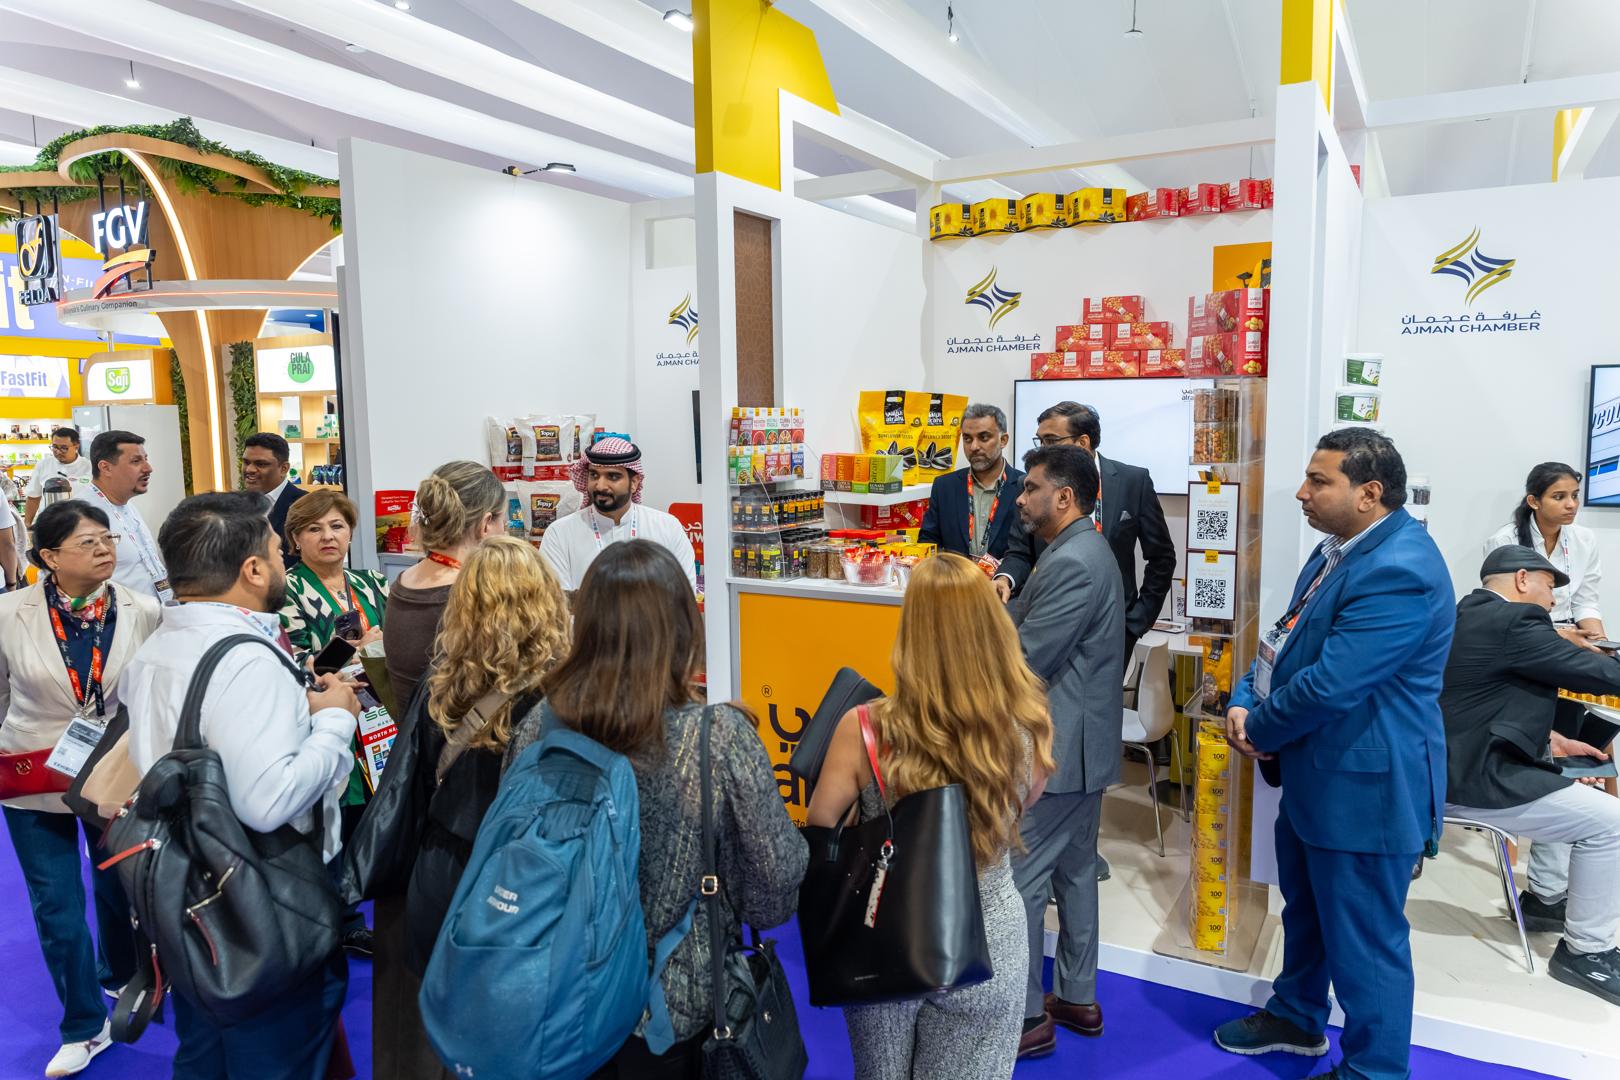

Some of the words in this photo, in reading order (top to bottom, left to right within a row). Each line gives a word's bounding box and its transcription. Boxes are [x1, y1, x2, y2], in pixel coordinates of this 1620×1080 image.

[92, 201, 145, 254] FGV
[19, 287, 51, 305] FELDA
[80, 302, 101, 312] Culinary
[101, 301, 138, 310] Companion
[1401, 314, 1470, 325] عجمان
[1475, 310, 1541, 321] غرفة
[1401, 325, 1455, 335] AJMAN
[1459, 322, 1541, 332] CHAMBER
[946, 345, 984, 354] AJMAN
[986, 343, 1041, 352] CHAMBER
[290, 352, 310, 364] GULA
[291, 363, 310, 375] PRAI
[0, 371, 48, 387] FastFit
[108, 372, 129, 390] Saji
